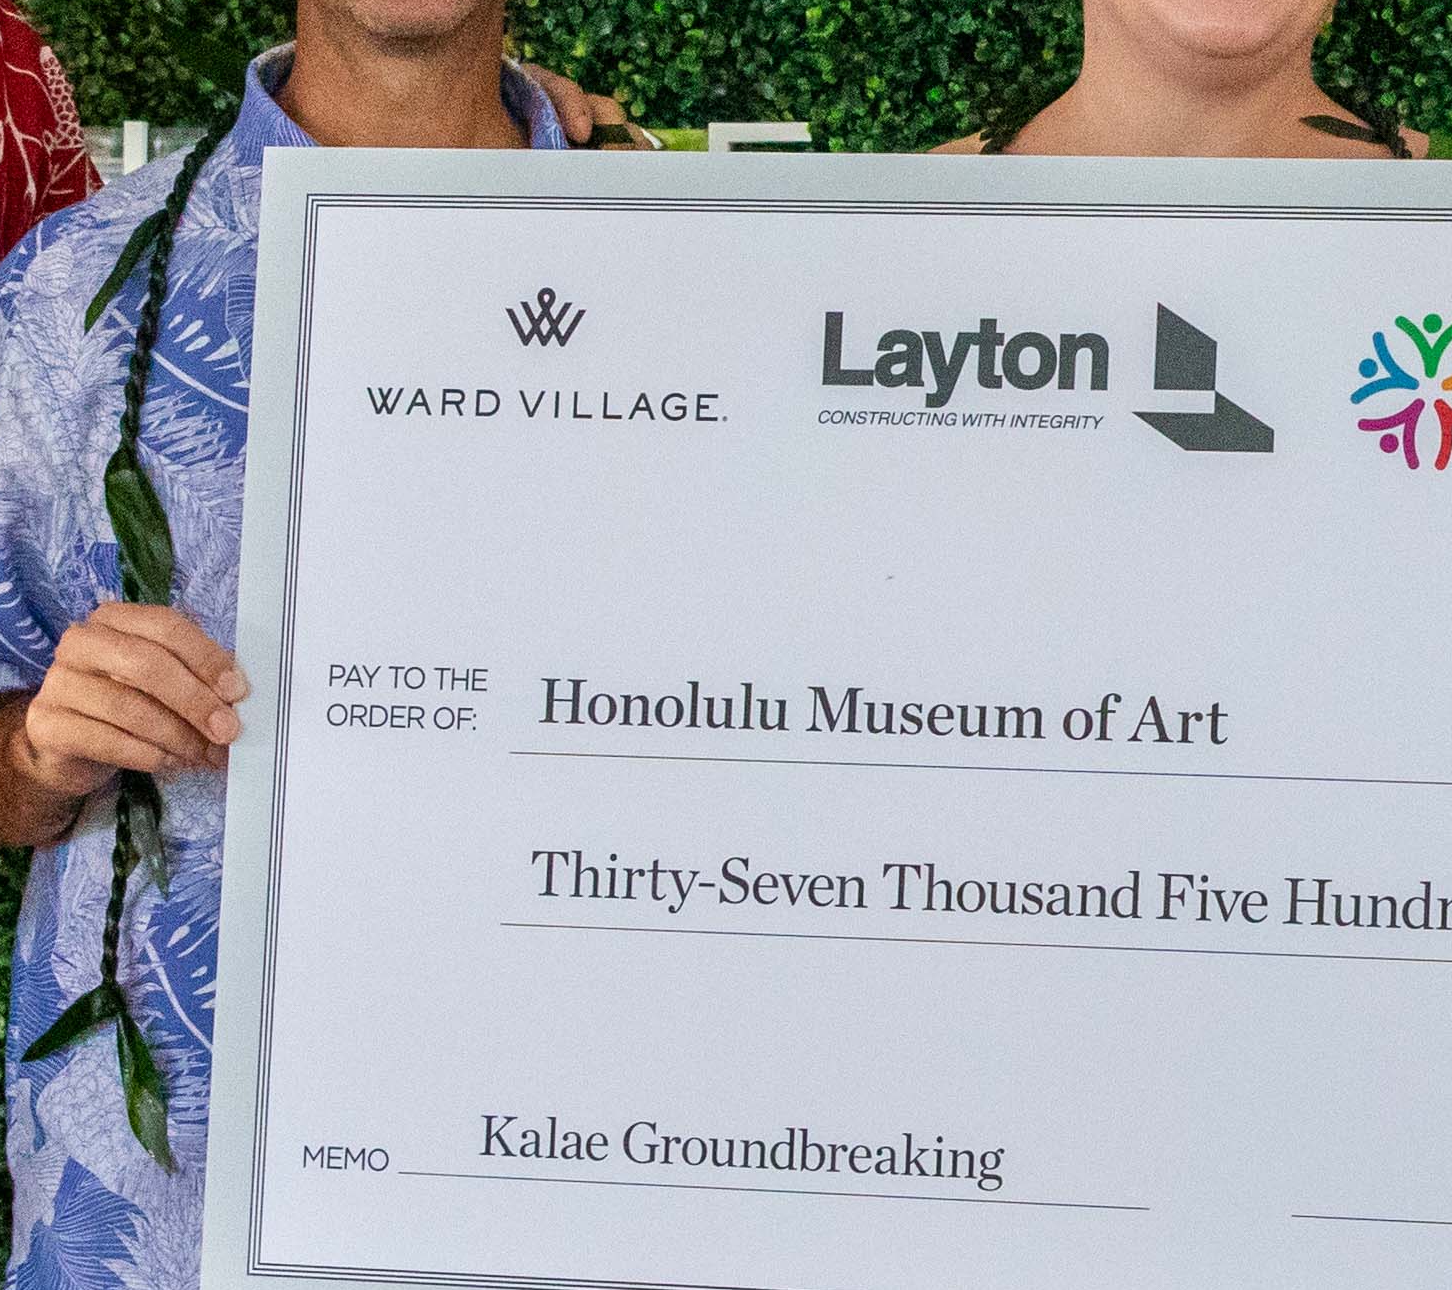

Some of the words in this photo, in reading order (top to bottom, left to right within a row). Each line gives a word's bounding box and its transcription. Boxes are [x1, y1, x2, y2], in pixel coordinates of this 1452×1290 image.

[821, 311, 1110, 409] Layton
[366, 386, 501, 417] WARD
[817, 409, 958, 426] CONSTRUCTING
[961, 412, 1006, 427] WITH
[1009, 414, 1104, 430] INTEGRITY
[328, 664, 381, 688] PAY
[388, 665, 426, 690] TO
[433, 667, 489, 692] THE
[326, 703, 426, 729] ORDER
[433, 706, 478, 731] OF:
[538, 677, 790, 731] Honolulu
[805, 686, 1046, 739] Museum
[1062, 692, 1122, 742] of
[1127, 695, 1229, 746] Art
[531, 850, 868, 914] Thirty-Seven
[882, 862, 1142, 919] Thousand
[1156, 873, 1269, 924] Five
[303, 1145, 390, 1172] MEMO
[479, 1114, 609, 1162] Kalae
[622, 1121, 1005, 1192] Groundbreaking
